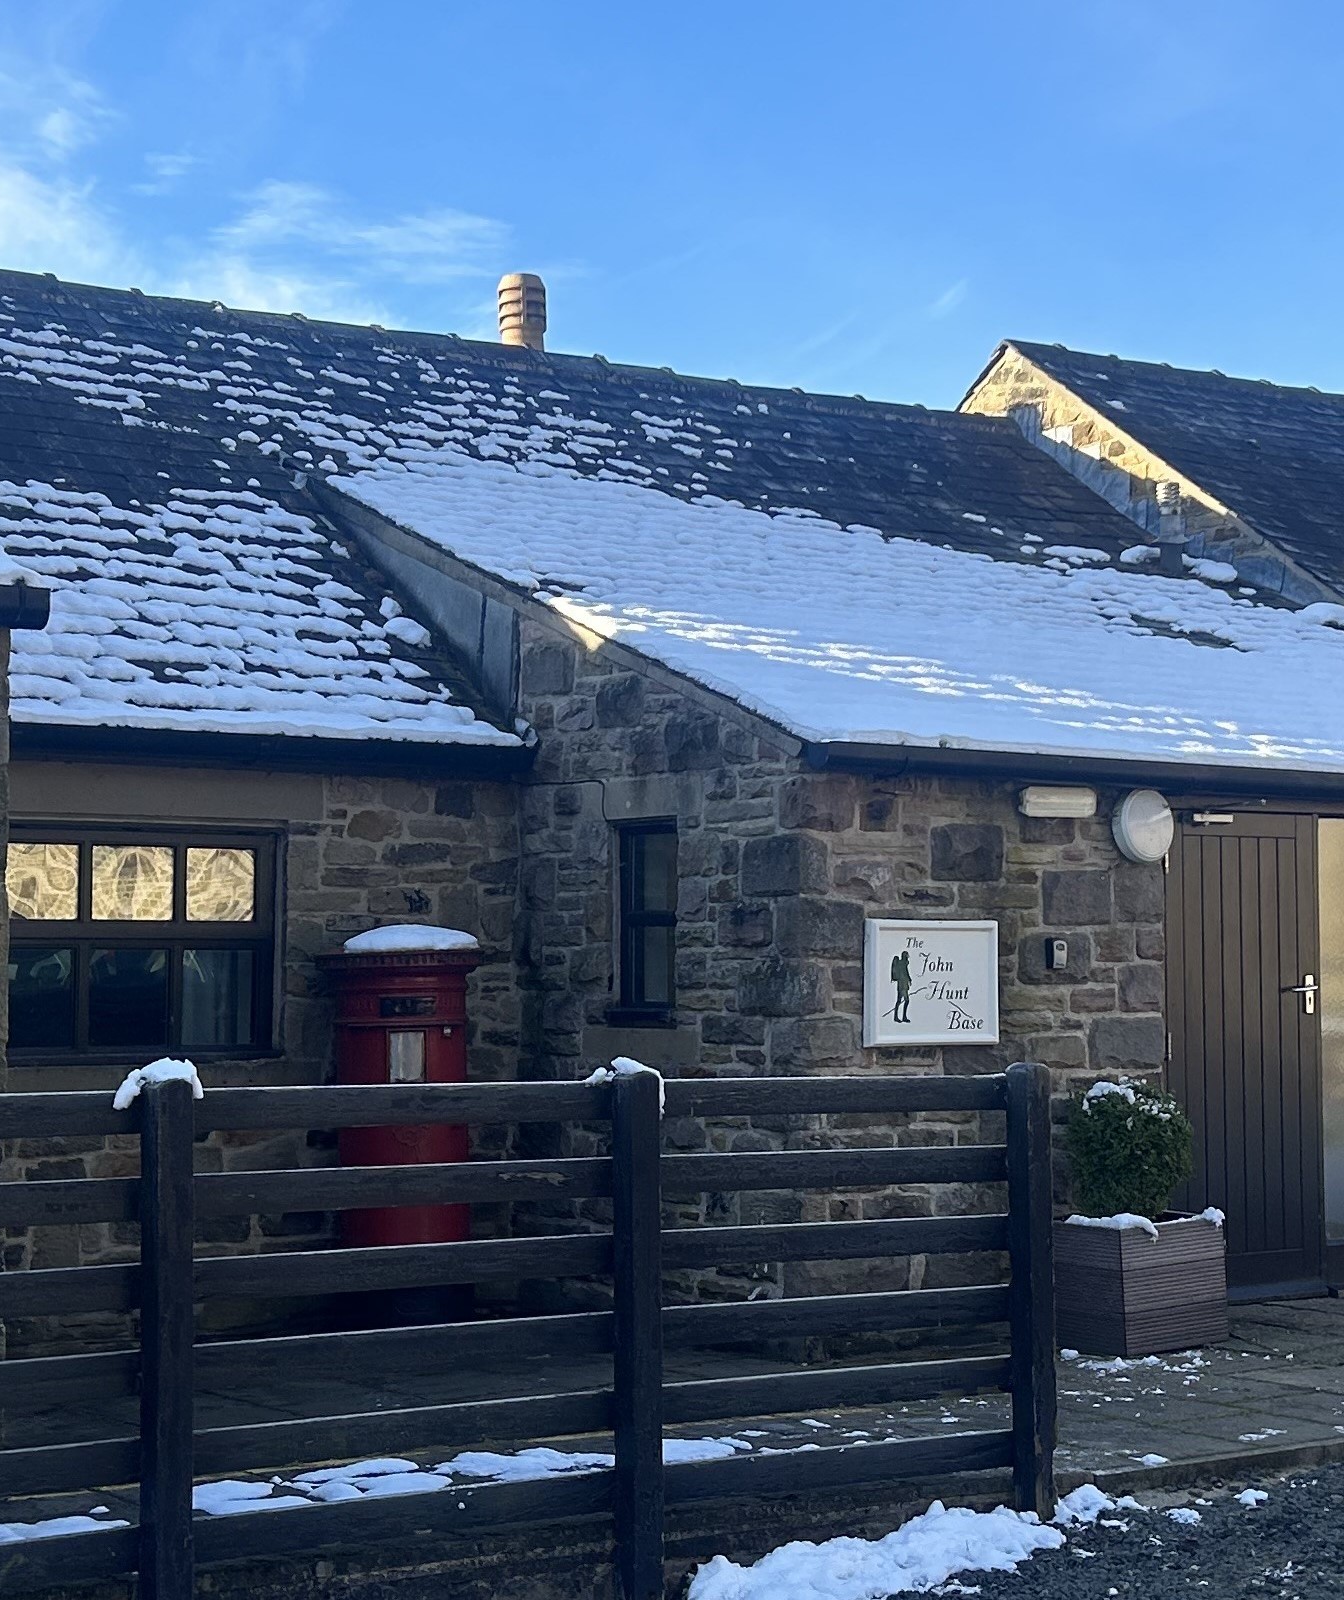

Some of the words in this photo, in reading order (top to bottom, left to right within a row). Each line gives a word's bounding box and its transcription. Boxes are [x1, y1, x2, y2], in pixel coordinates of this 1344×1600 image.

[906, 937, 924, 948] The
[918, 952, 954, 978] John
[925, 980, 969, 1000] Hunt
[947, 1010, 984, 1030] Base
